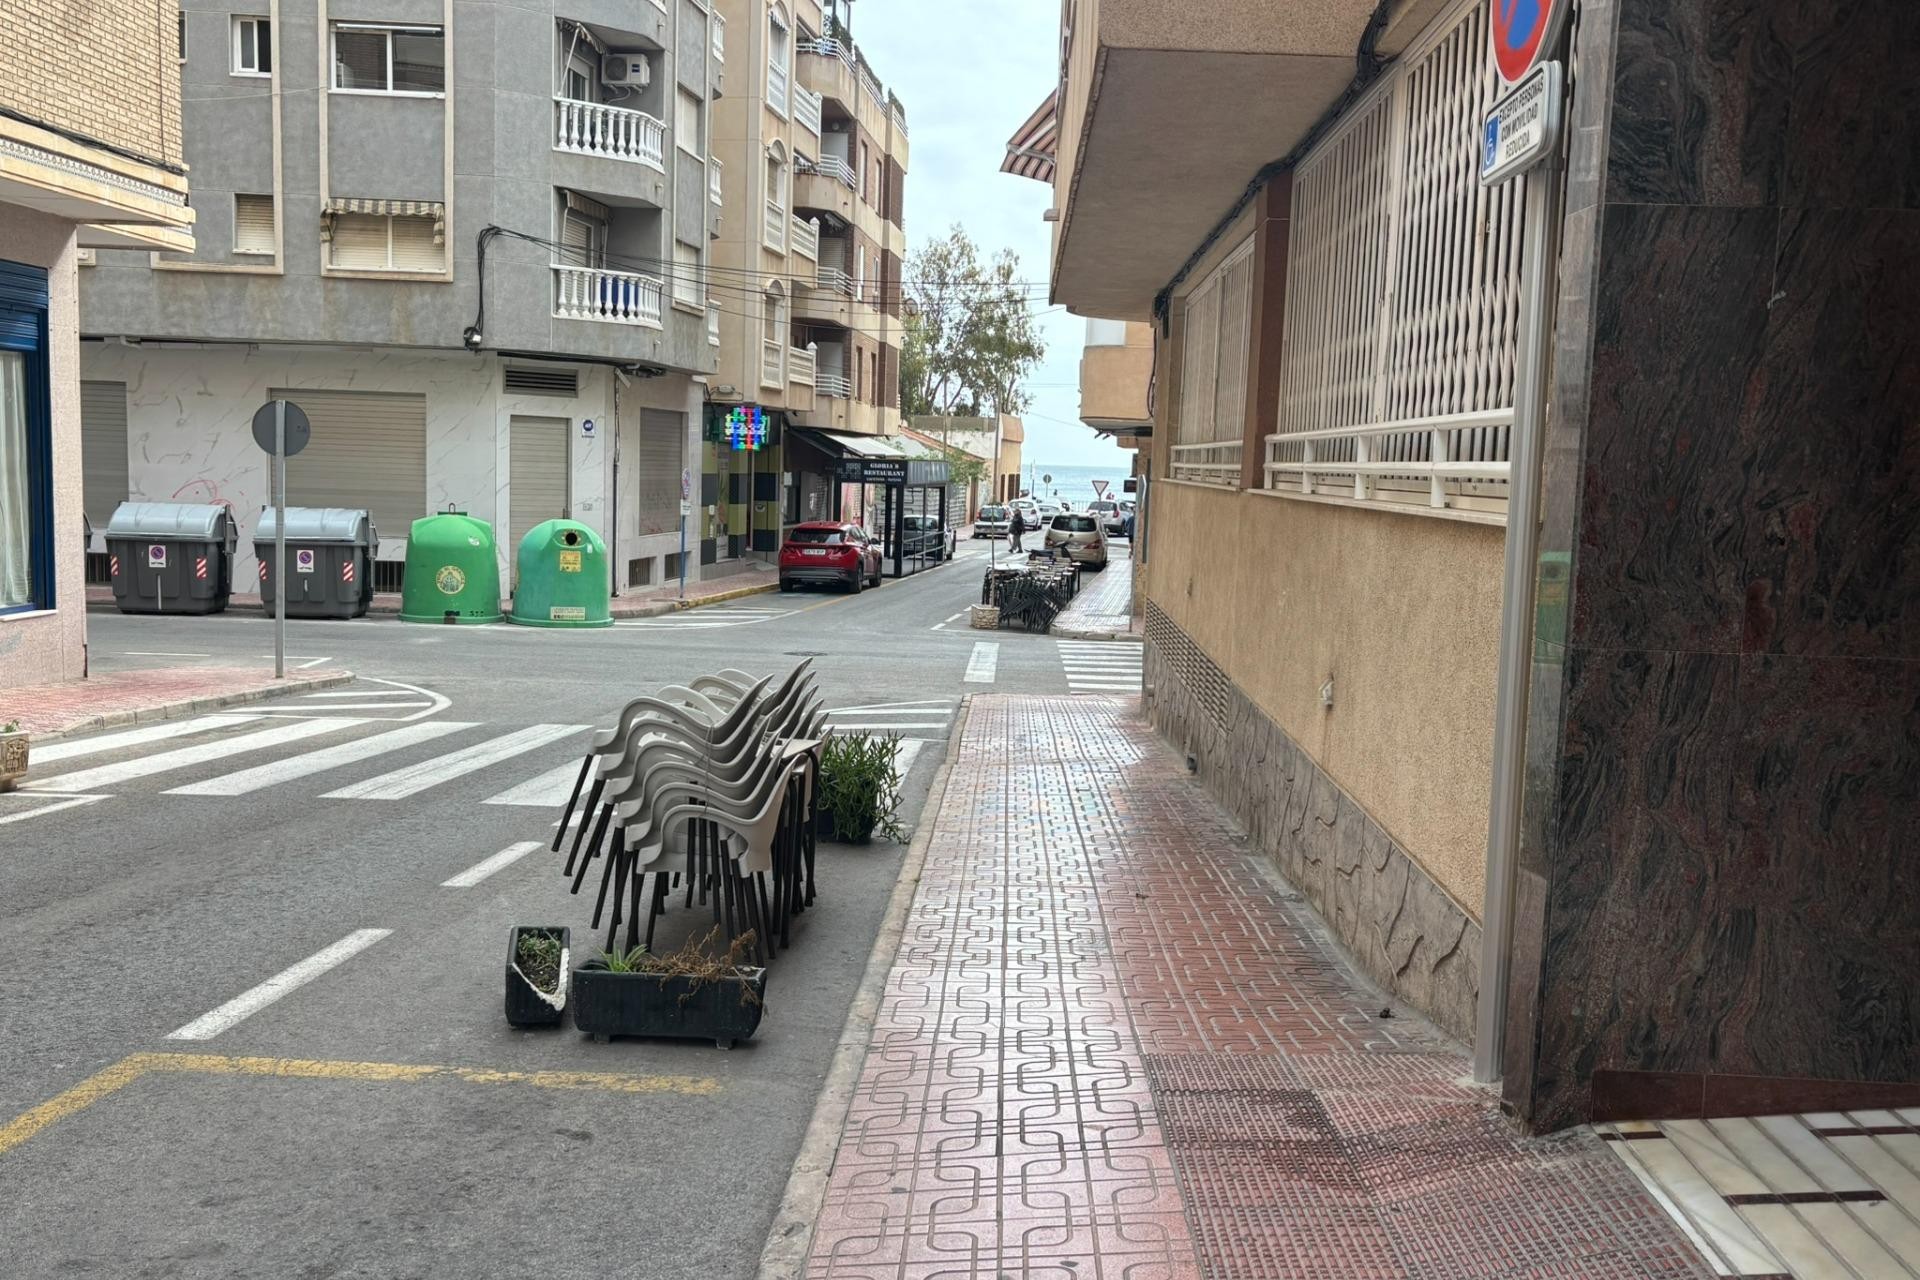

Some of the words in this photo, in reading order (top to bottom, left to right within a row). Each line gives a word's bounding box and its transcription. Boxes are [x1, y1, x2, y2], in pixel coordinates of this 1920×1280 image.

[1499, 96, 1519, 124] EXCEPTO
[1519, 75, 1544, 107] PERSONAS
[1501, 121, 1512, 142] CON
[1511, 102, 1538, 134] MOVILIDAD
[1505, 129, 1530, 160] REDUCIDA
